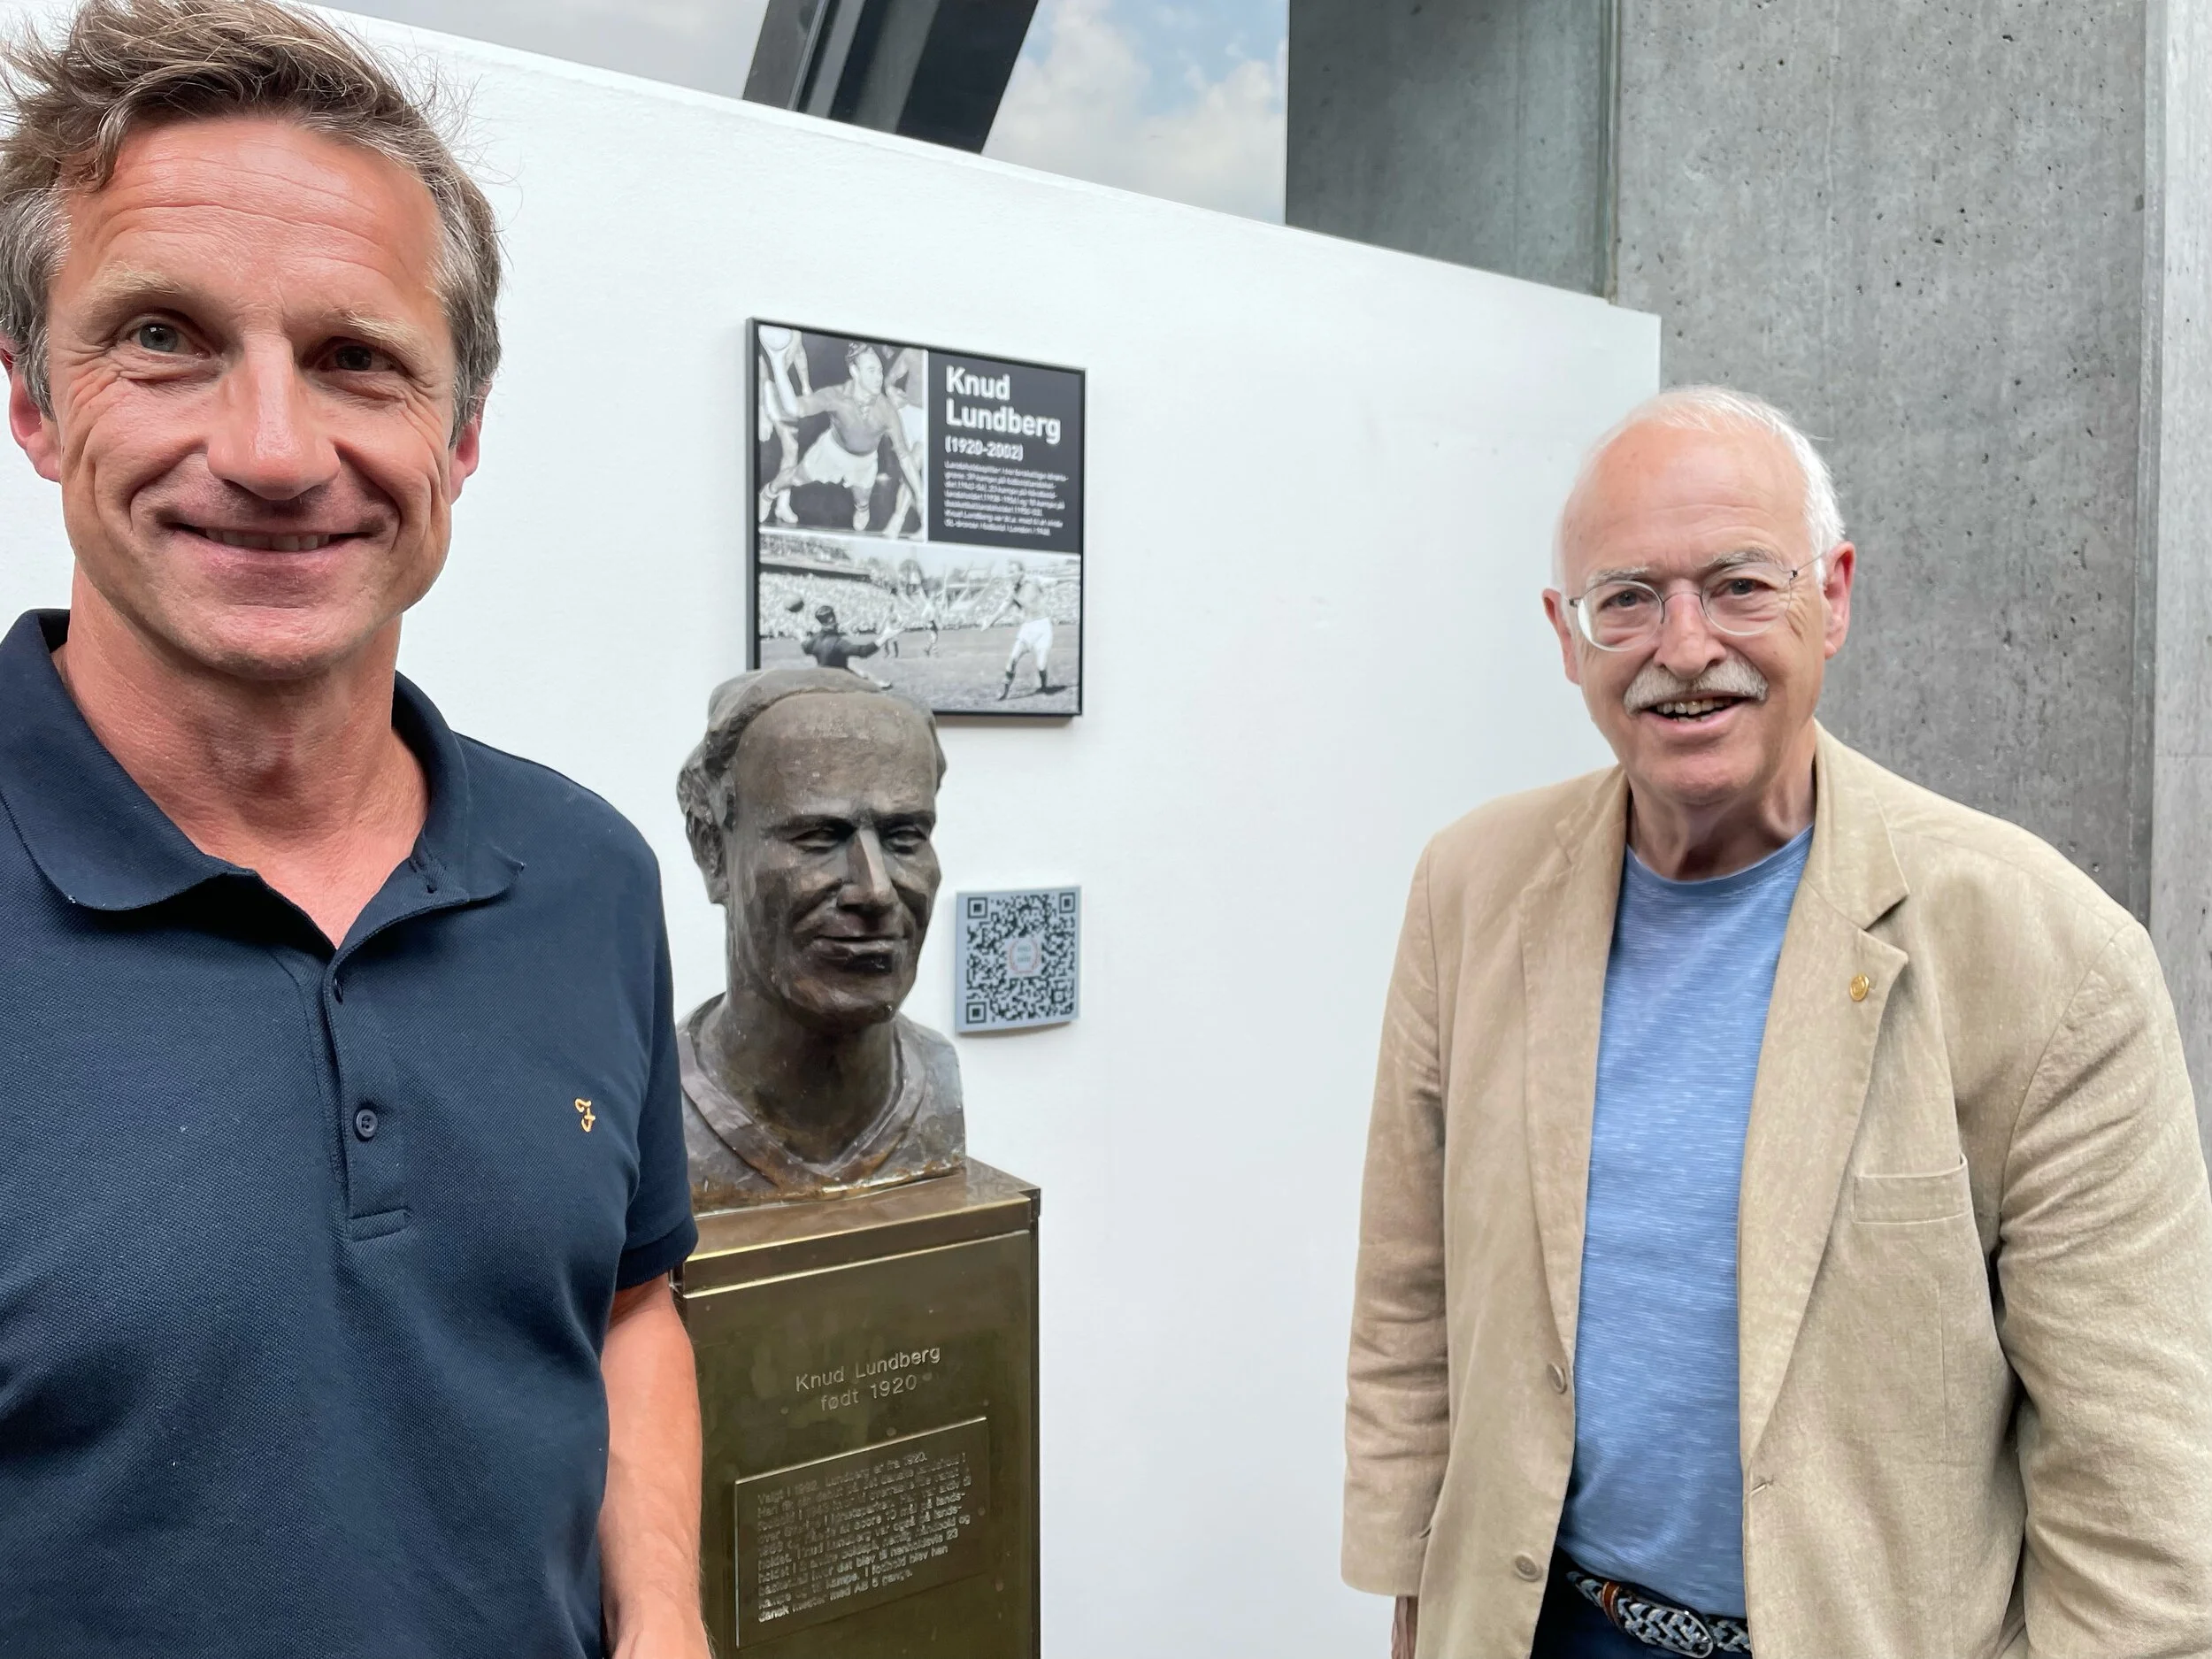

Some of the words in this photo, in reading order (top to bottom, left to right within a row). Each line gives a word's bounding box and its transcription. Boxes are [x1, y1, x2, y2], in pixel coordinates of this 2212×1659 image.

[946, 365, 1010, 400] Knud
[946, 398, 1061, 445] Lundberg
[945, 434, 1024, 462] (1920-2002)
[795, 1365, 845, 1393] Knud
[855, 1347, 941, 1379] Lundberg
[820, 1387, 860, 1412] født
[870, 1373, 918, 1399] 1920
